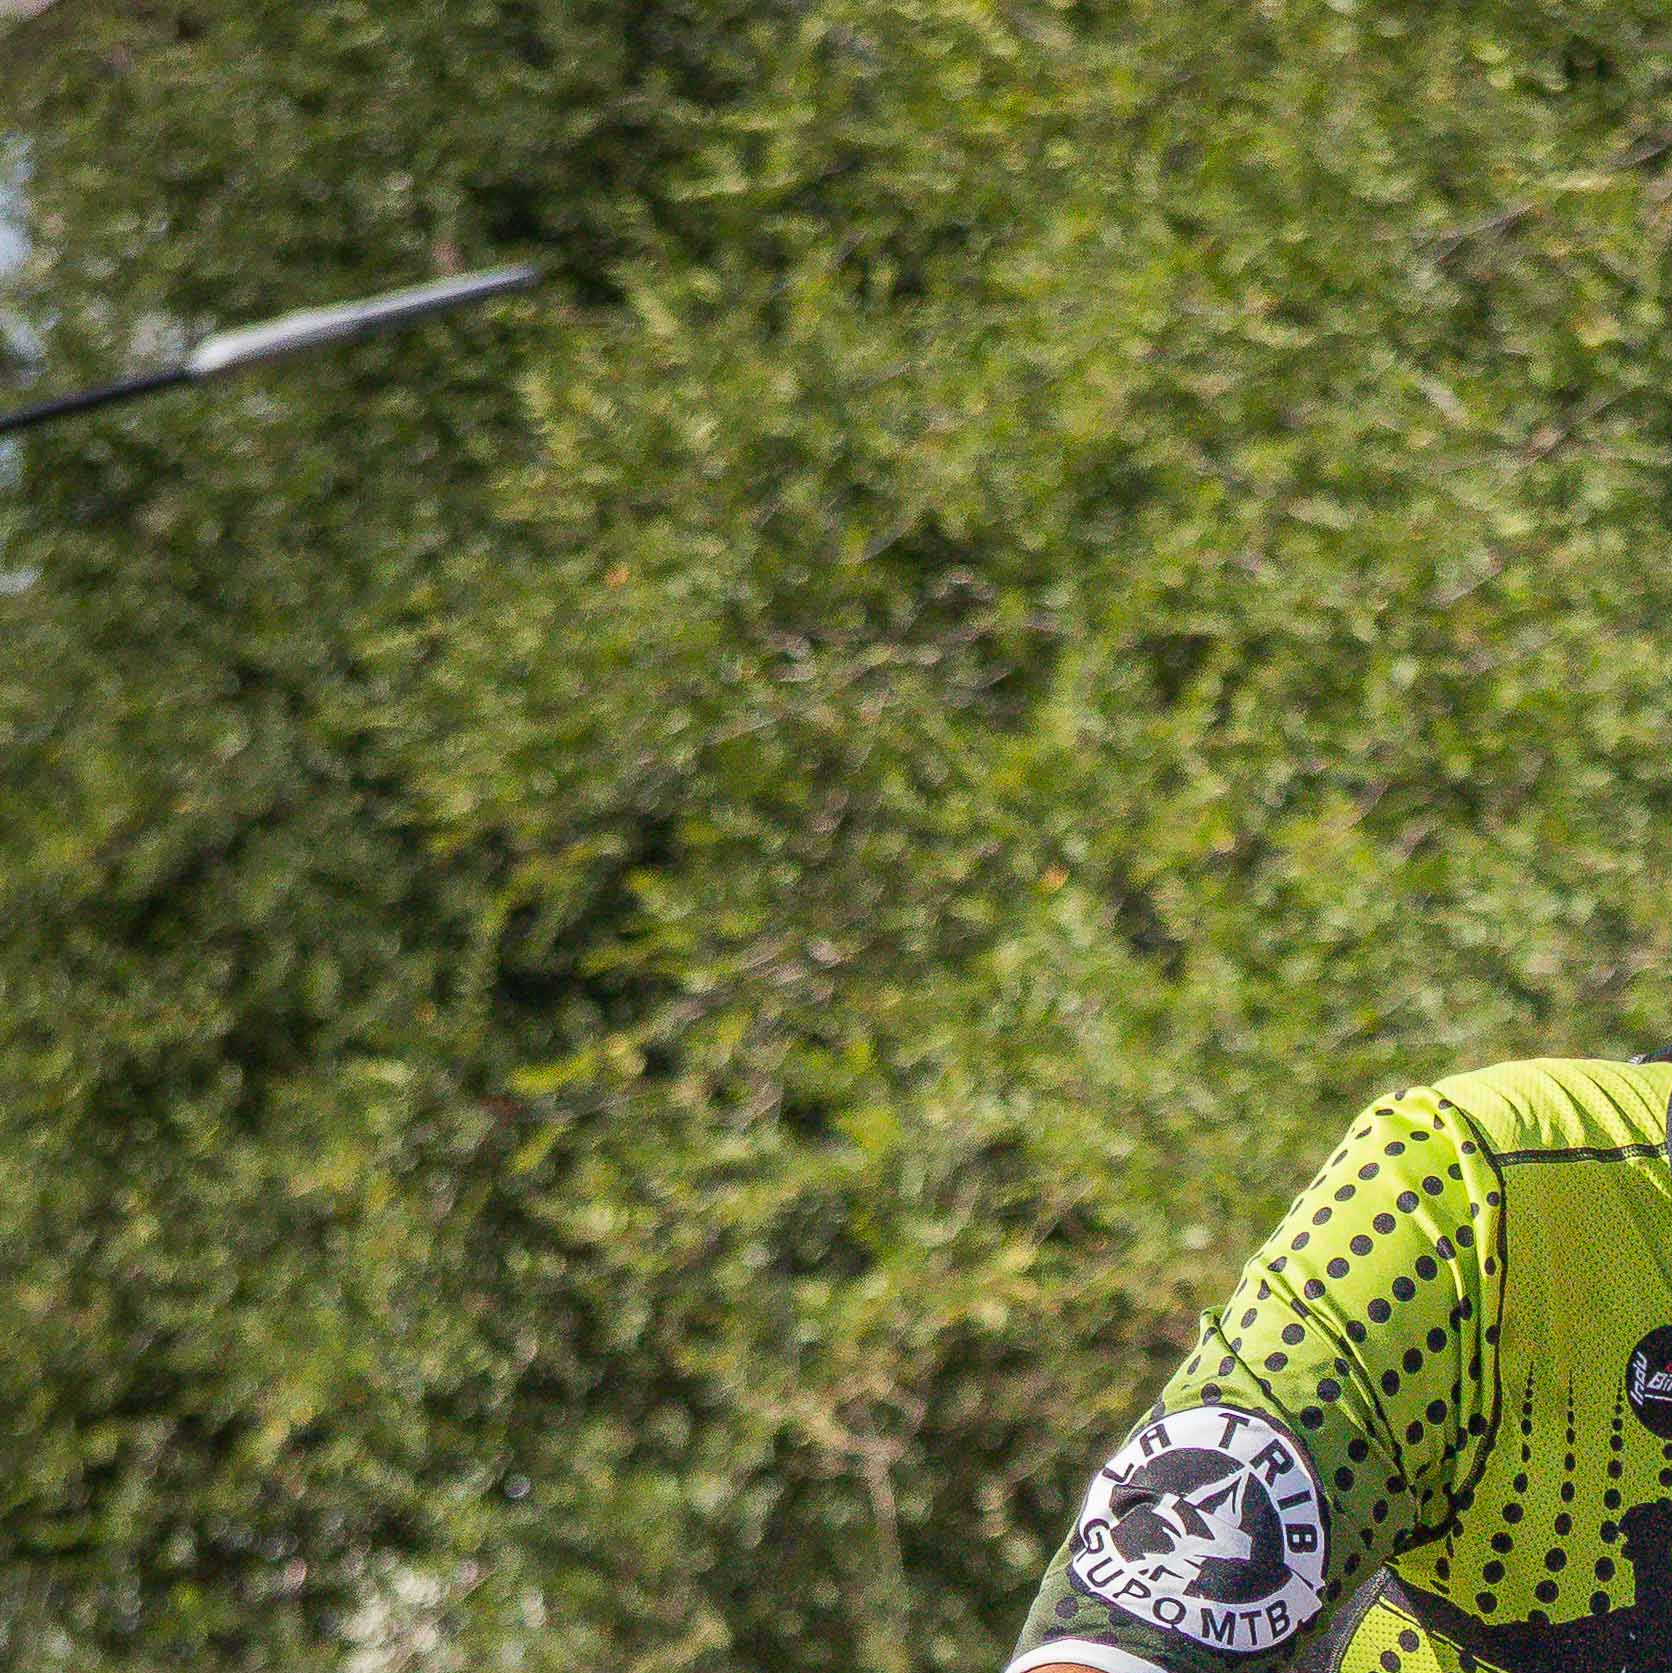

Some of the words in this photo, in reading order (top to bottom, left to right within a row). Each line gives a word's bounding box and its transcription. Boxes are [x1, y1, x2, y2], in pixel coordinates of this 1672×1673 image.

[1101, 1423, 1172, 1484] LA
[1218, 1411, 1319, 1590] TRIB
[1083, 1518, 1187, 1626] GUPO
[1199, 1599, 1291, 1646] MTB
